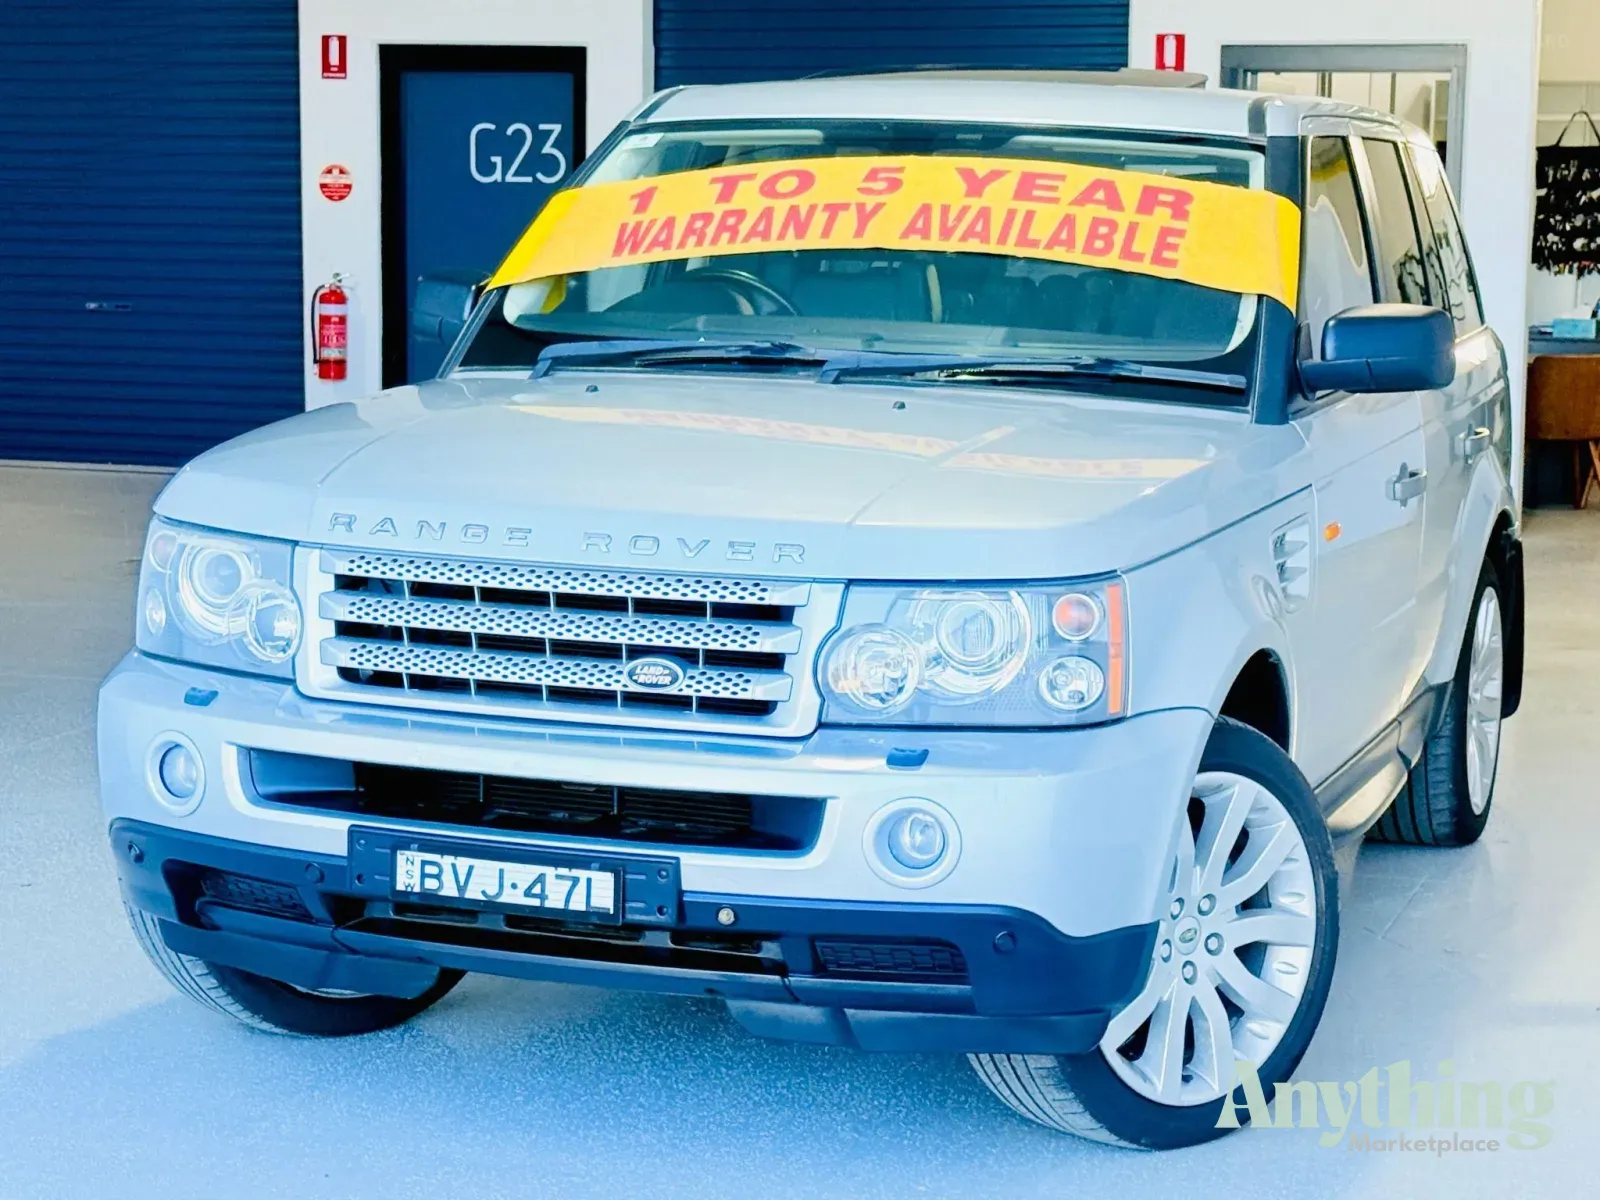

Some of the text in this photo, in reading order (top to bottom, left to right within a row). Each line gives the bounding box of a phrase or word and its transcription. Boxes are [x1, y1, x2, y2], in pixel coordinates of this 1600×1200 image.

[469, 122, 566, 183] G23
[628, 166, 1195, 221] 1 TO 5 YEAR
[611, 202, 1187, 268] WARRANTY AVAILABLE
[328, 512, 806, 564] RANGE ROVER
